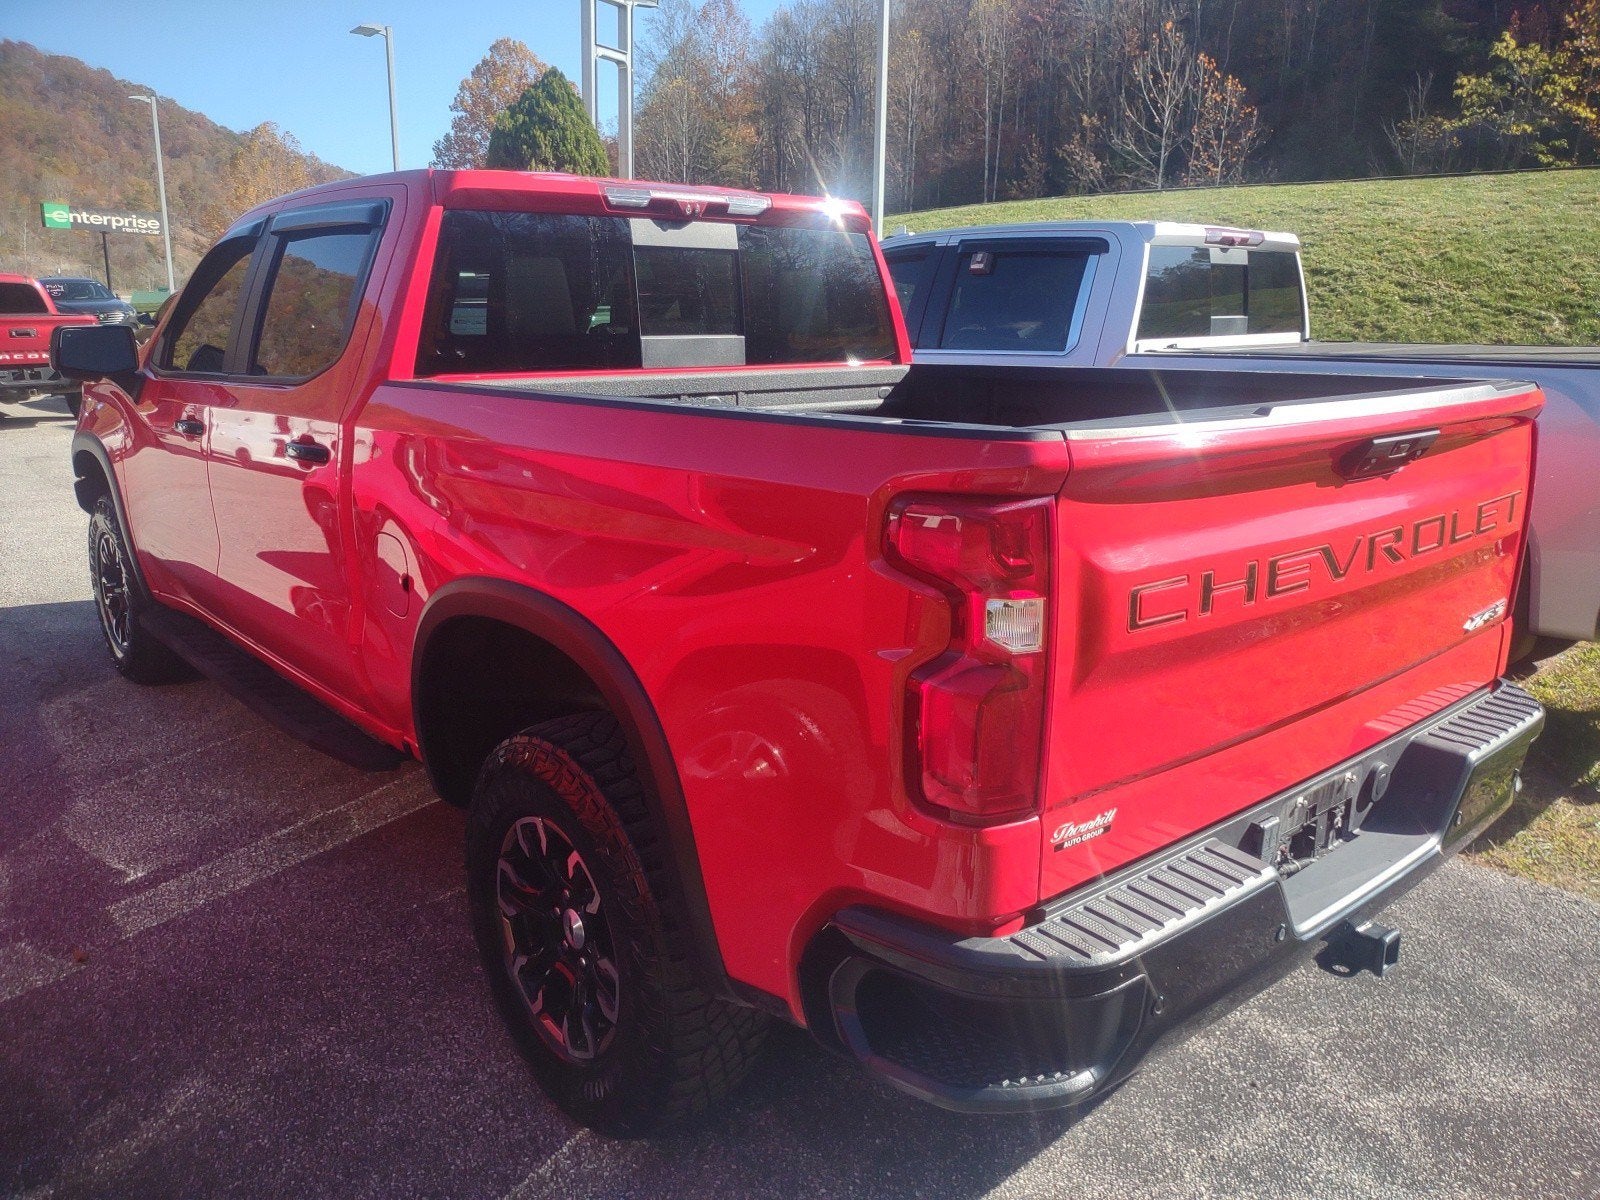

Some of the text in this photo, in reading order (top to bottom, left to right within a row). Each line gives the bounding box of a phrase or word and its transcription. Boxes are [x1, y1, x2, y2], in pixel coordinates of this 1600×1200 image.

[45, 210, 160, 230] enterprise
[122, 227, 160, 235] rent-a-car
[1127, 490, 1522, 634] CHEVROLET
[1050, 808, 1118, 843] Thornhill
[1063, 828, 1104, 849] AUTO GROUP
